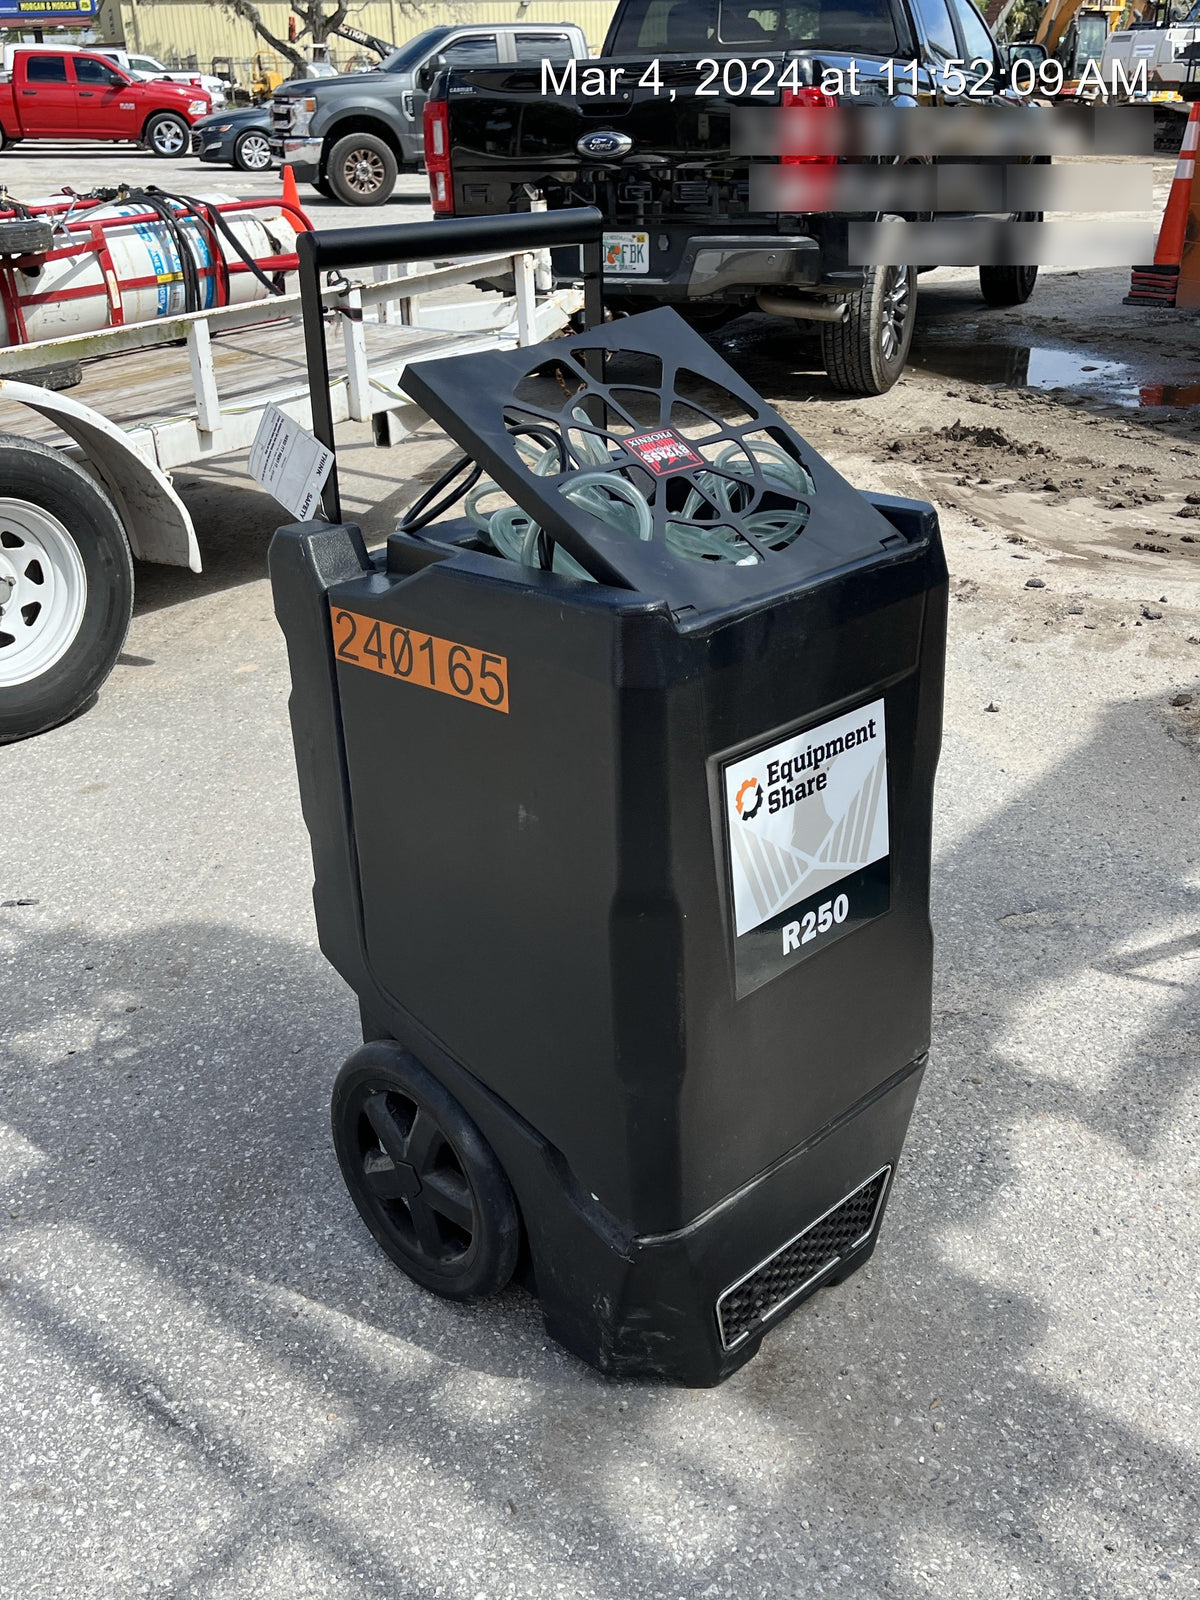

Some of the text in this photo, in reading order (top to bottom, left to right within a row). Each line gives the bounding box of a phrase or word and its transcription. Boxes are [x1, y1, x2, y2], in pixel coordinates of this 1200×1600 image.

[20, 2, 46, 11] MORGAN
[52, 1, 77, 10] MORGAN
[589, 137, 613, 150] Ford
[628, 431, 673, 447] PHOENIX
[316, 452, 328, 476] THINK
[643, 444, 691, 463] BYPASS
[300, 492, 313, 520] SAFETY
[336, 611, 504, 706] 240165
[766, 718, 877, 787] Equipment
[768, 771, 828, 815] Share
[783, 893, 849, 956] R250
